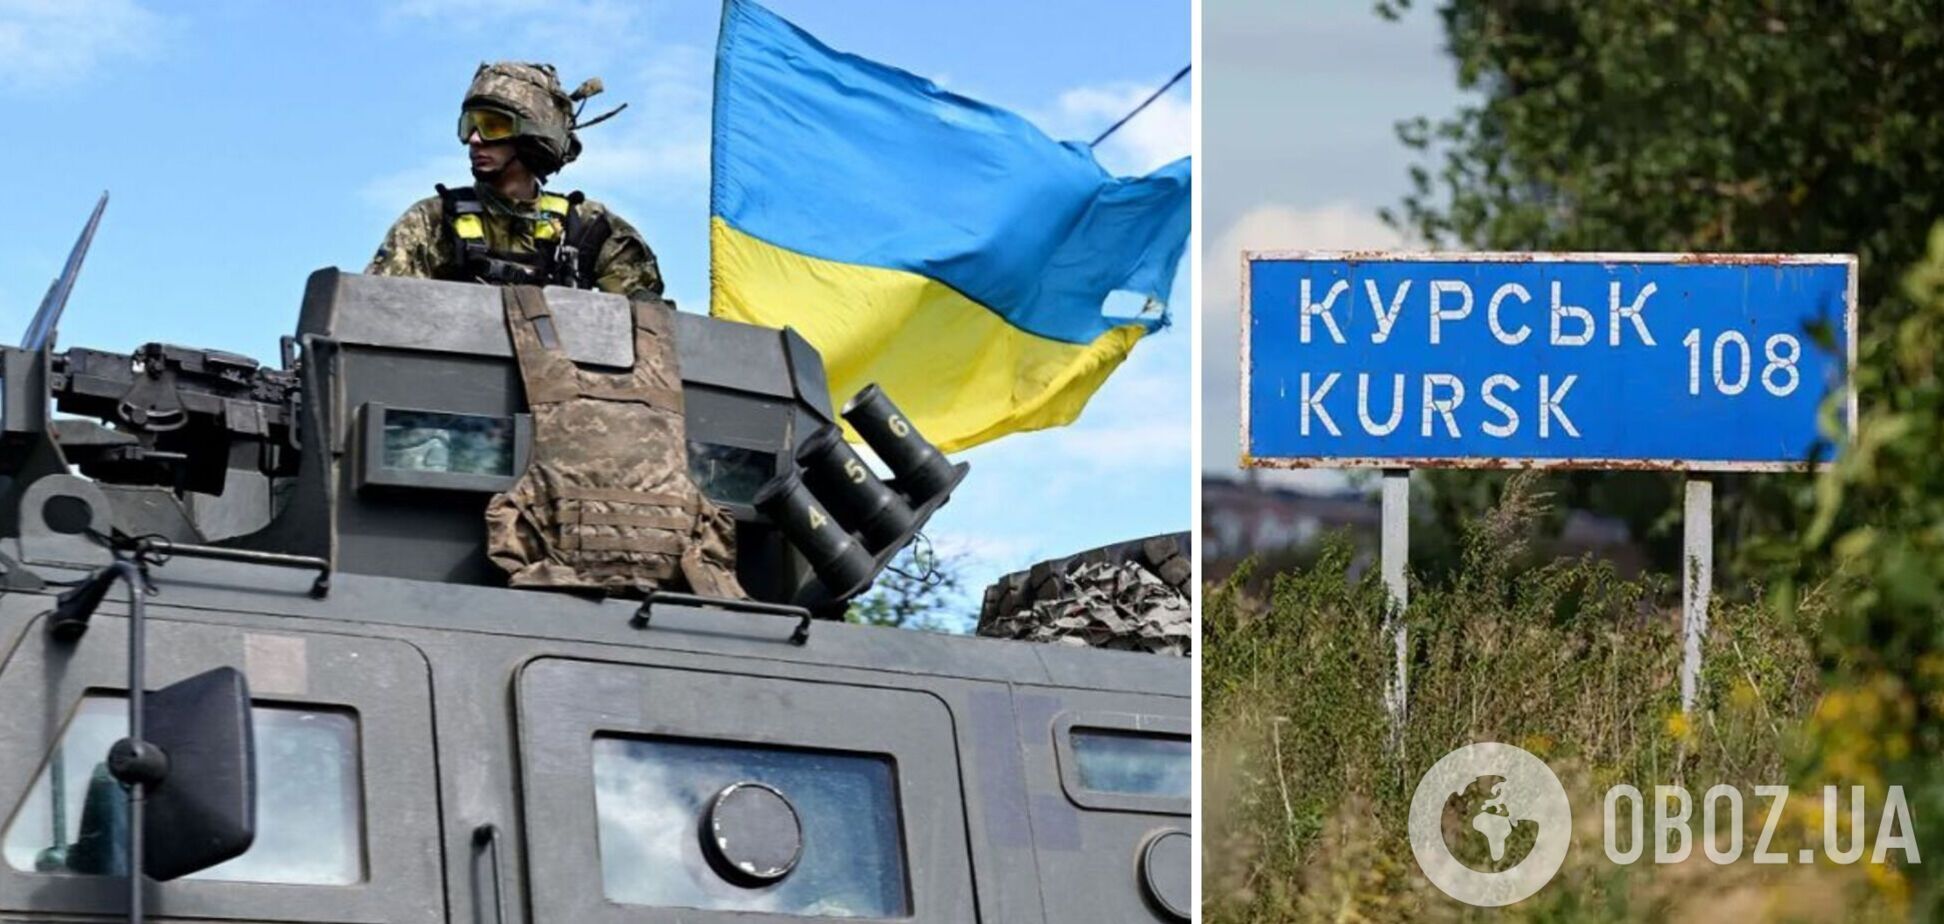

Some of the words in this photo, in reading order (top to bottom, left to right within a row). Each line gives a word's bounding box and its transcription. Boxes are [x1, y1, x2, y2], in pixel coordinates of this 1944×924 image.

[1299, 278, 1657, 347] КУРСЬК
[1682, 327, 1801, 397] 108
[888, 414, 910, 438] 6
[1299, 372, 1581, 439] KURSK
[844, 459, 867, 484] 5
[808, 505, 828, 530] 4
